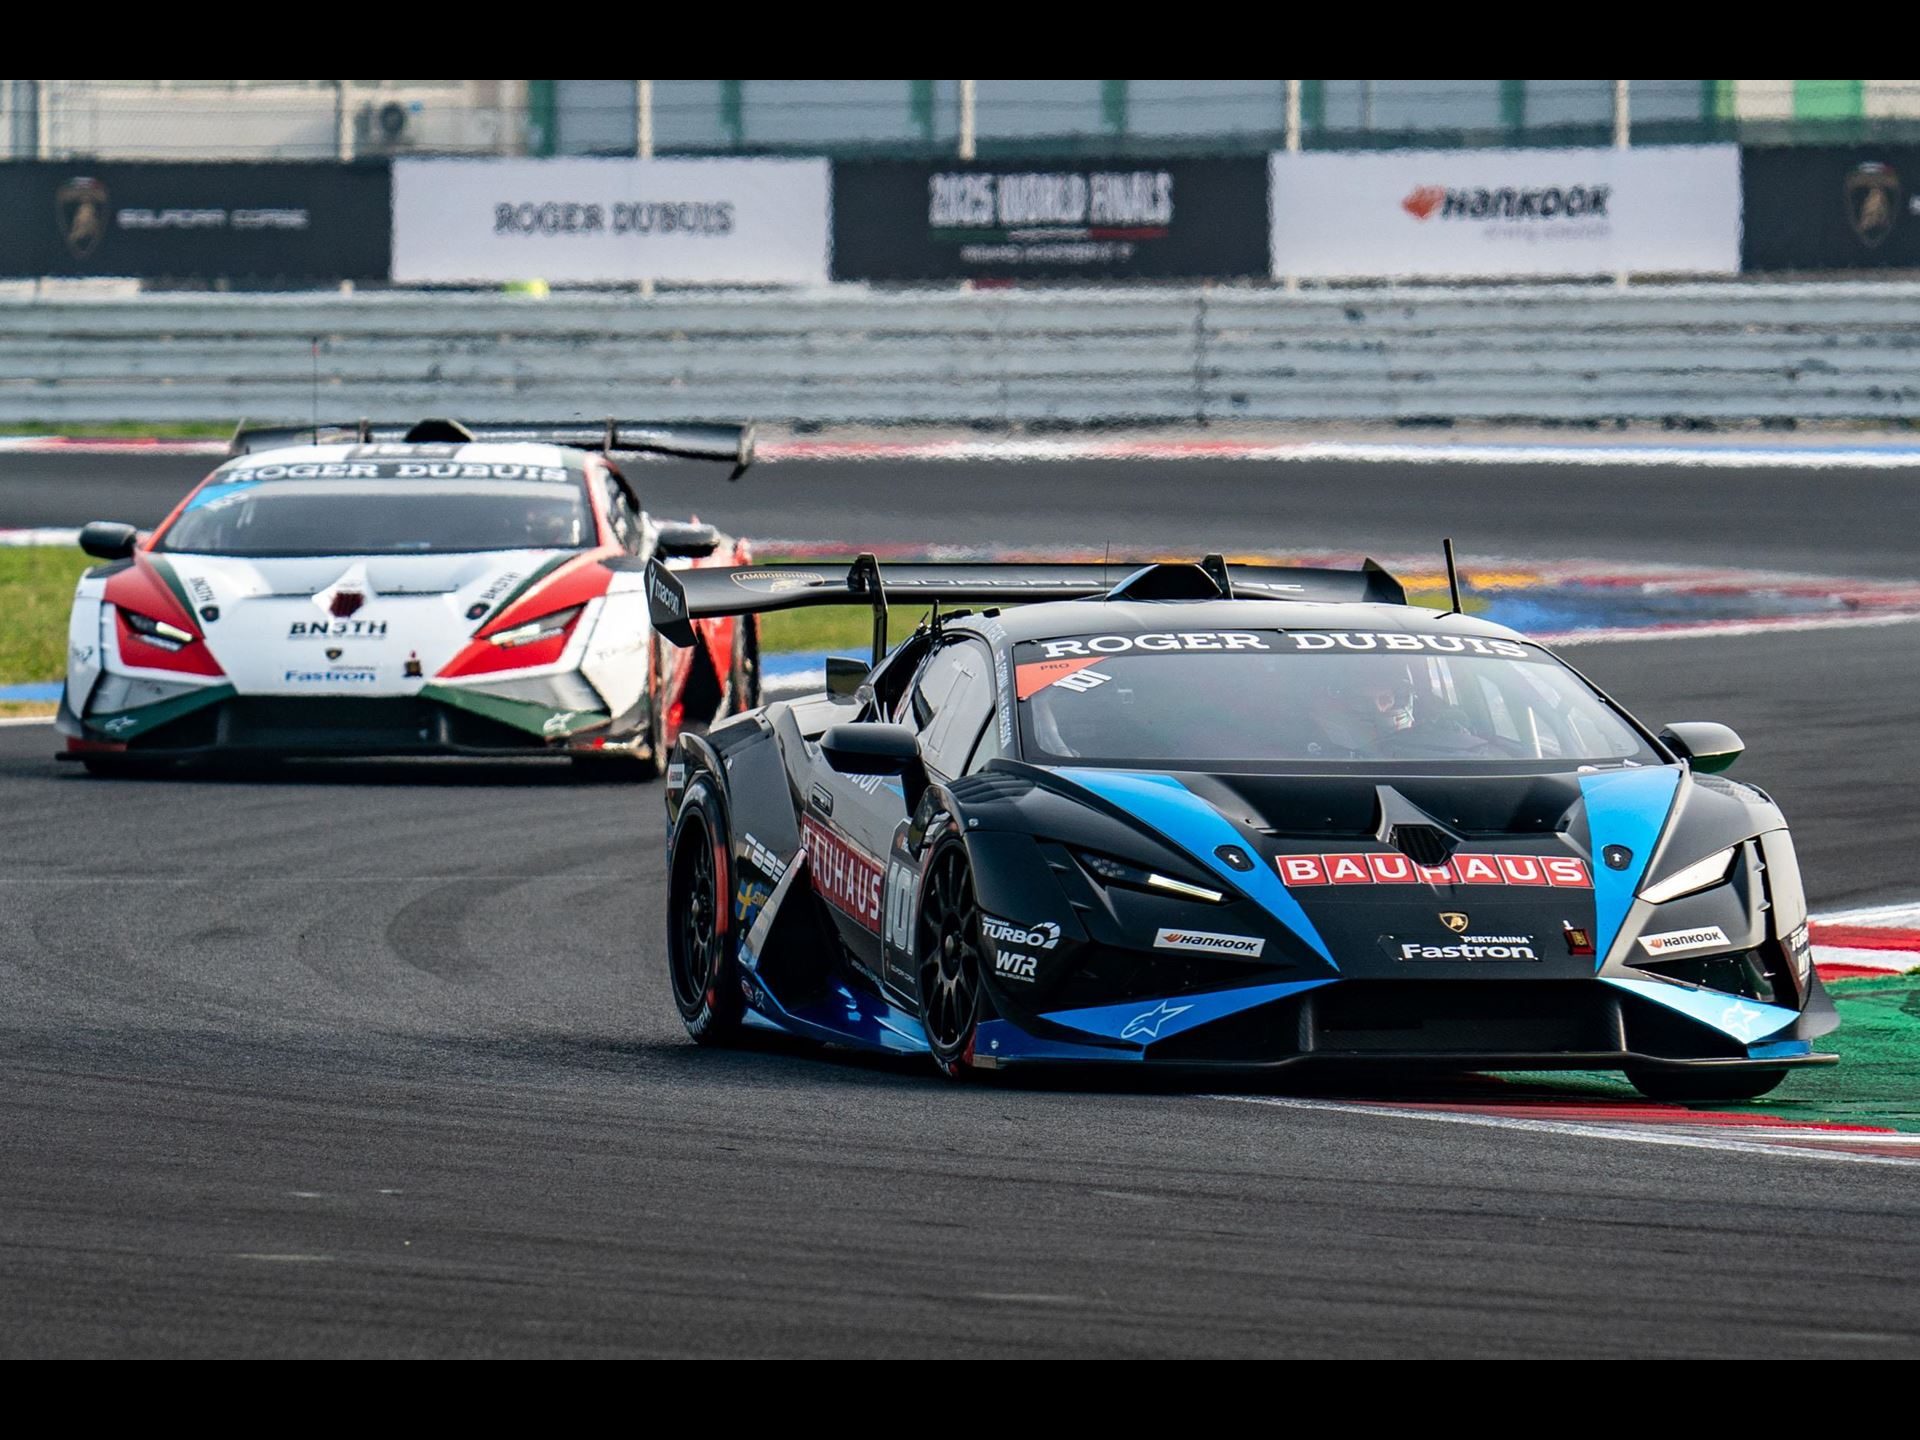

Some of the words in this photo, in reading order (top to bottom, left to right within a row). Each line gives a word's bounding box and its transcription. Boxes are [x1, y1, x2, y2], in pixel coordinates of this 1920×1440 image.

[495, 201, 603, 235] ROGER
[611, 201, 735, 235] DUBUIS
[225, 464, 380, 482] ROGER
[395, 463, 568, 482] DUBUIS
[1041, 630, 1270, 658] ROGER
[1288, 631, 1529, 659] DUBUIS
[285, 670, 376, 683] Fastron
[1040, 663, 1070, 671] PRO
[1052, 668, 1113, 693] 101
[1285, 857, 1584, 883] BAUHAUS
[982, 922, 1045, 946] TURBO
[1461, 936, 1530, 944] PERTAMINA
[996, 949, 1038, 977] WTR
[1401, 943, 1535, 960] Fastron
